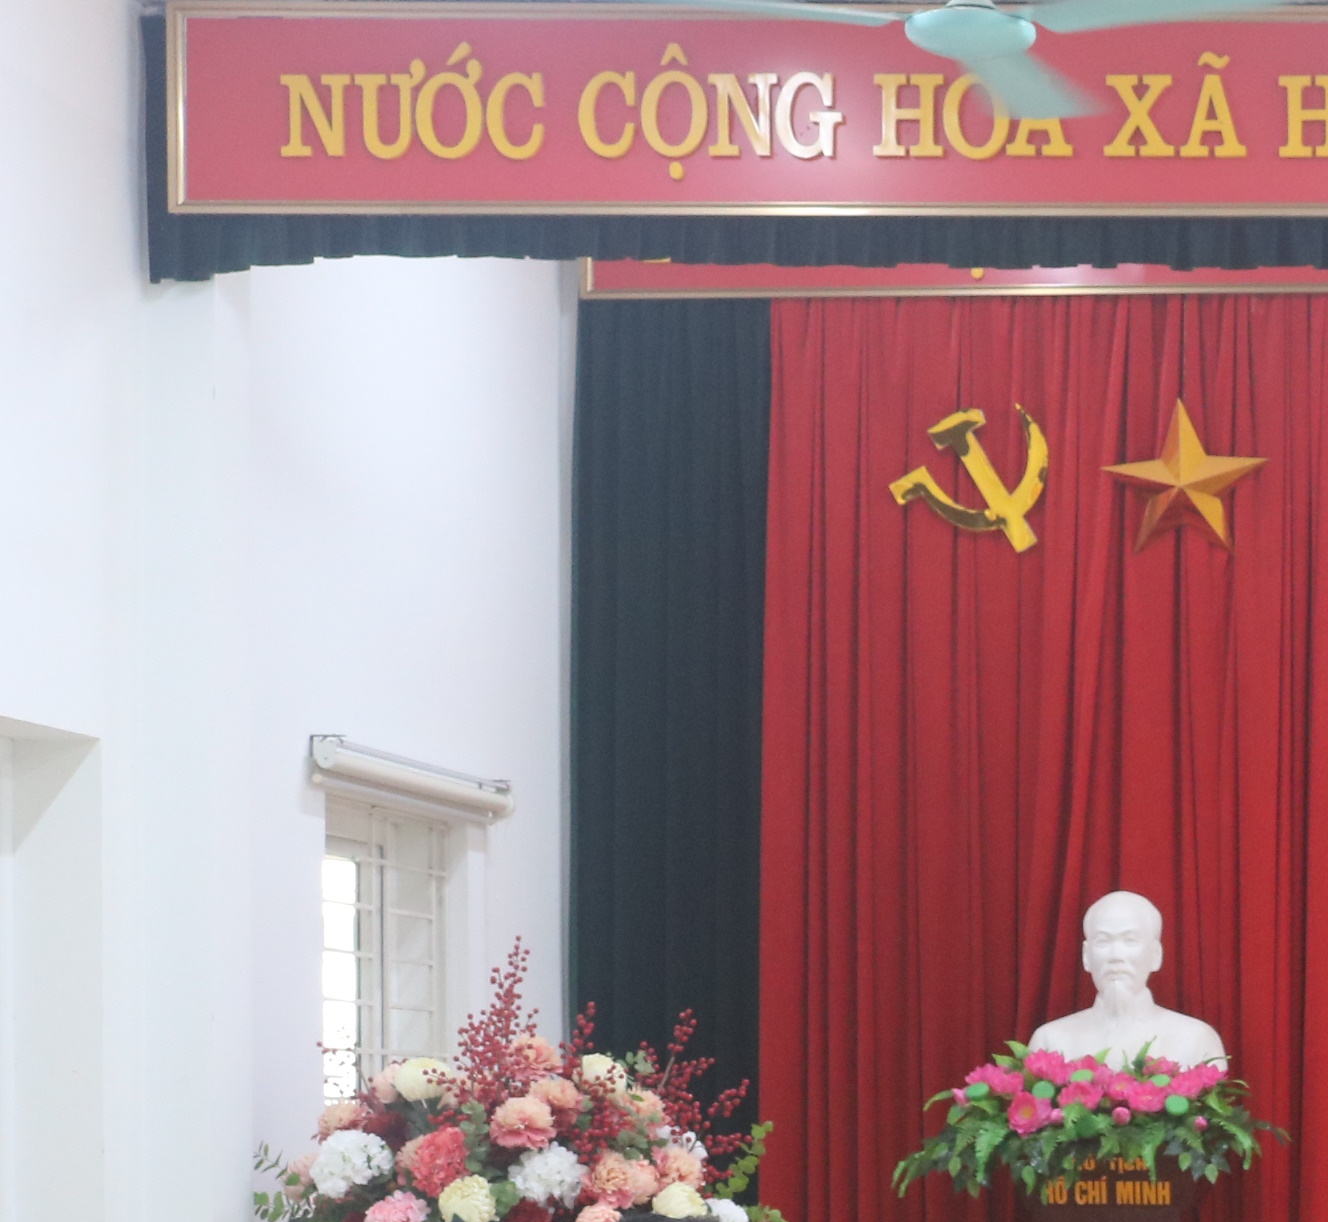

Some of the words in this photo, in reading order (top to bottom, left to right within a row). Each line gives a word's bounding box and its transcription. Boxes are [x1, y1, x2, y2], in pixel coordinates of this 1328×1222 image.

[279, 43, 545, 160] NƯỚC
[578, 43, 845, 181] CỘNG
[1103, 51, 1249, 158] XÃ
[1074, 1175, 1108, 1206] CHÍ
[1115, 1180, 1172, 1206] MINH
